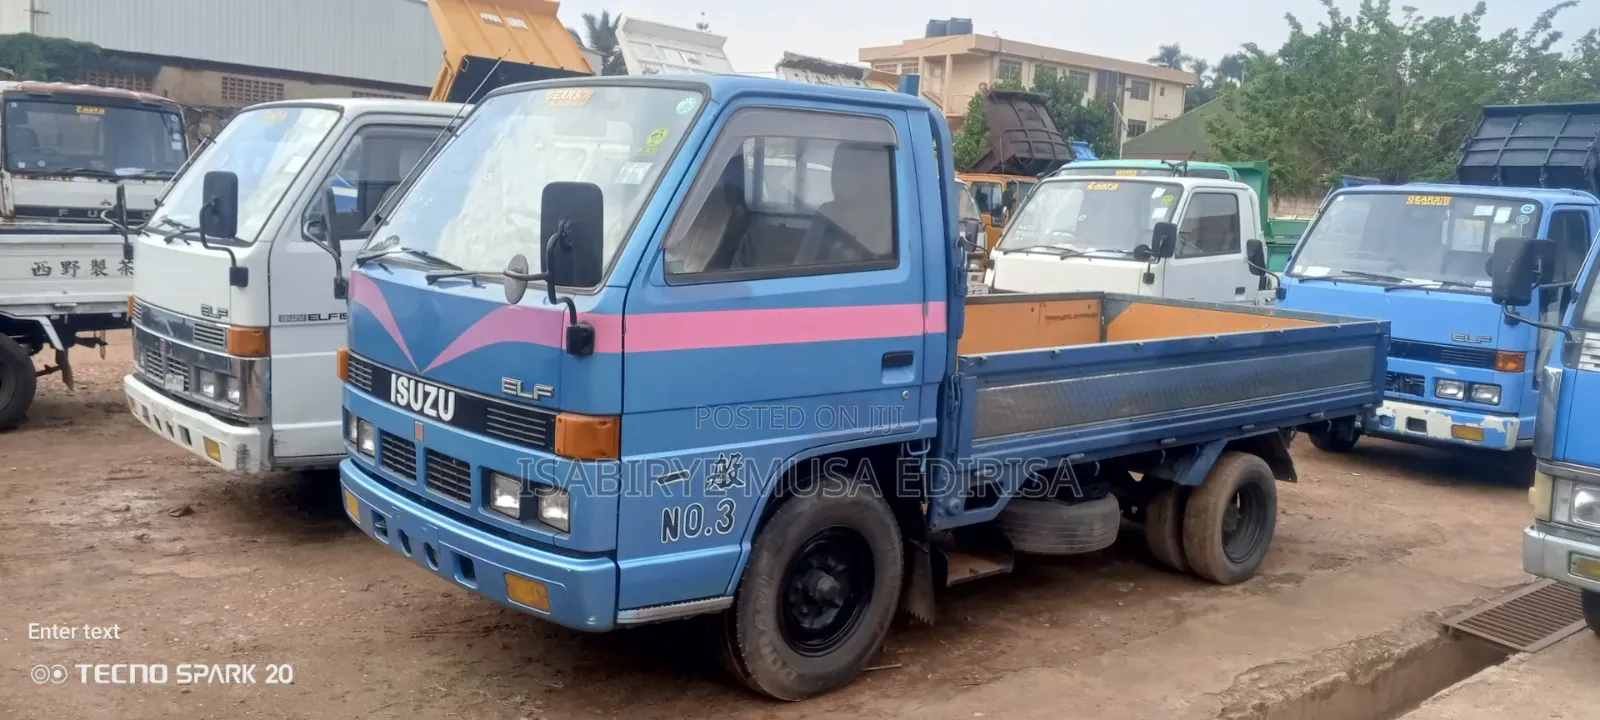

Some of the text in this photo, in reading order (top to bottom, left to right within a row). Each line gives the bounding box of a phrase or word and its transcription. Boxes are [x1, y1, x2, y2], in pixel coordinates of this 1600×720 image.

[1407, 195, 1441, 203] GEARS
[58, 208, 152, 219] FUO
[200, 303, 229, 319] ELF
[1451, 332, 1492, 344] ELF
[501, 376, 554, 400] ELF
[390, 373, 456, 422] ISUZU
[660, 497, 737, 544] NO.3
